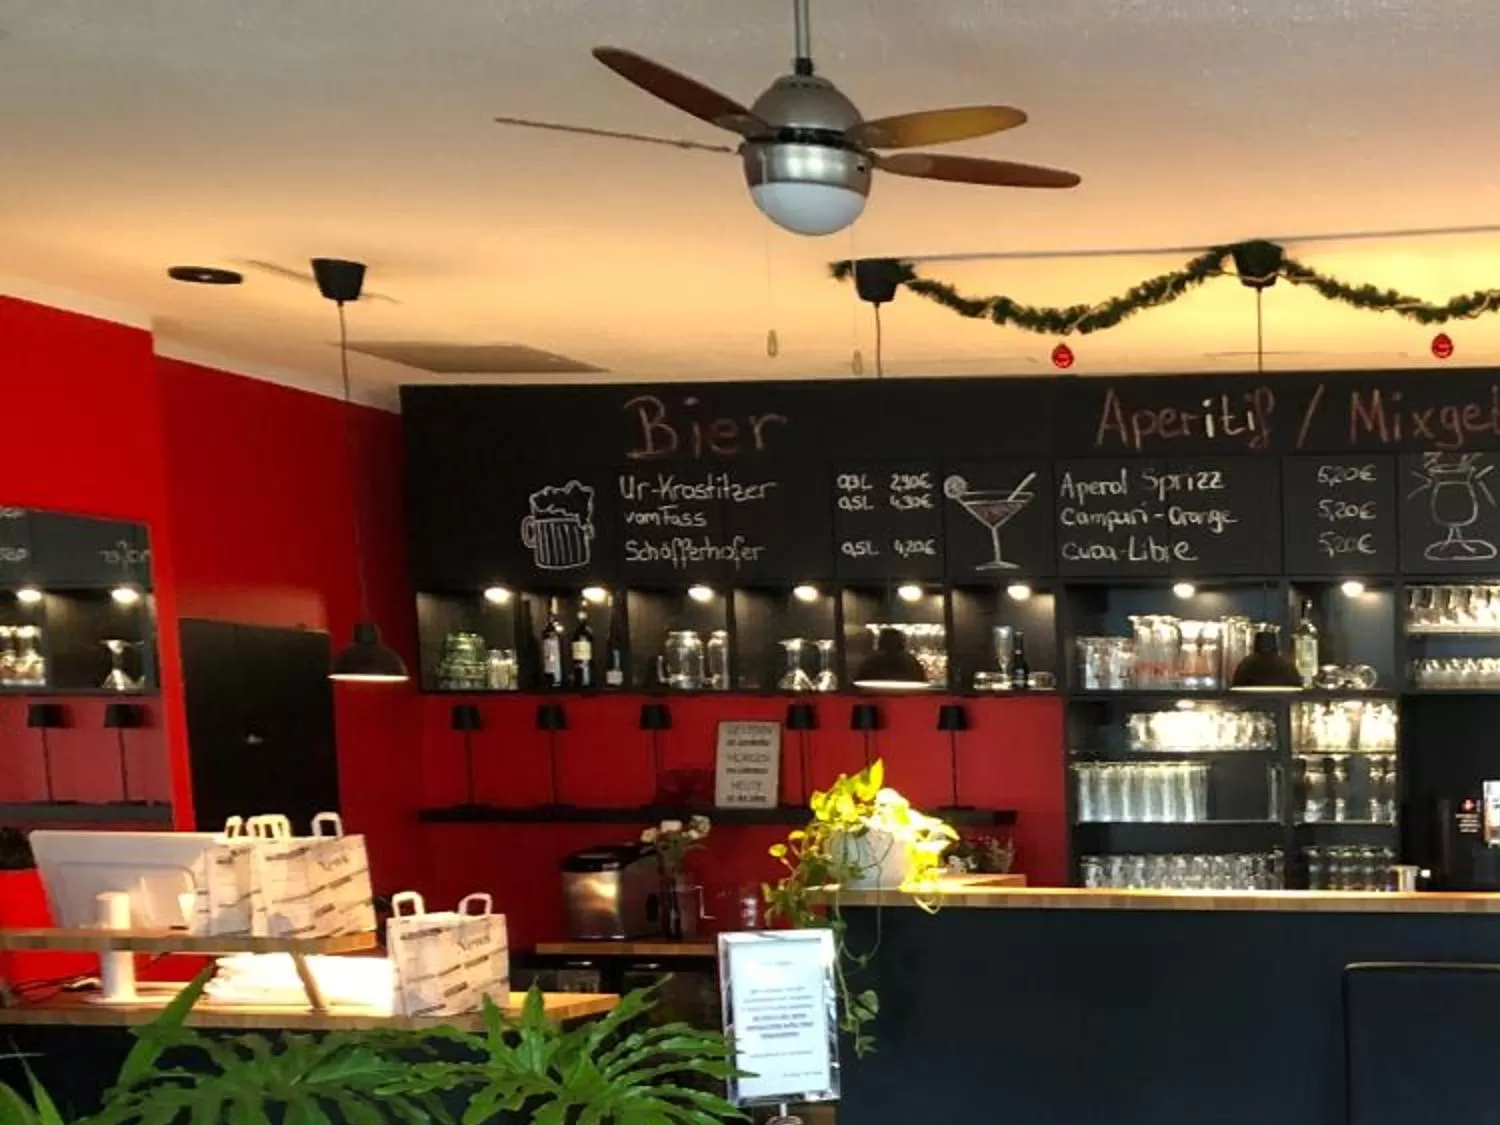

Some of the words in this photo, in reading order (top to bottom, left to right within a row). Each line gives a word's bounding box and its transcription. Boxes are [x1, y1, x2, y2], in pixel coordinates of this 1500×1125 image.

[623, 394, 787, 458] Bier
[1096, 386, 1276, 450] Aperitif
[1296, 383, 1325, 449] /
[1060, 467, 1128, 506] Aperol
[657, 503, 708, 527] Fass
[1059, 502, 1149, 533] Campari
[1127, 535, 1200, 564] Libre
